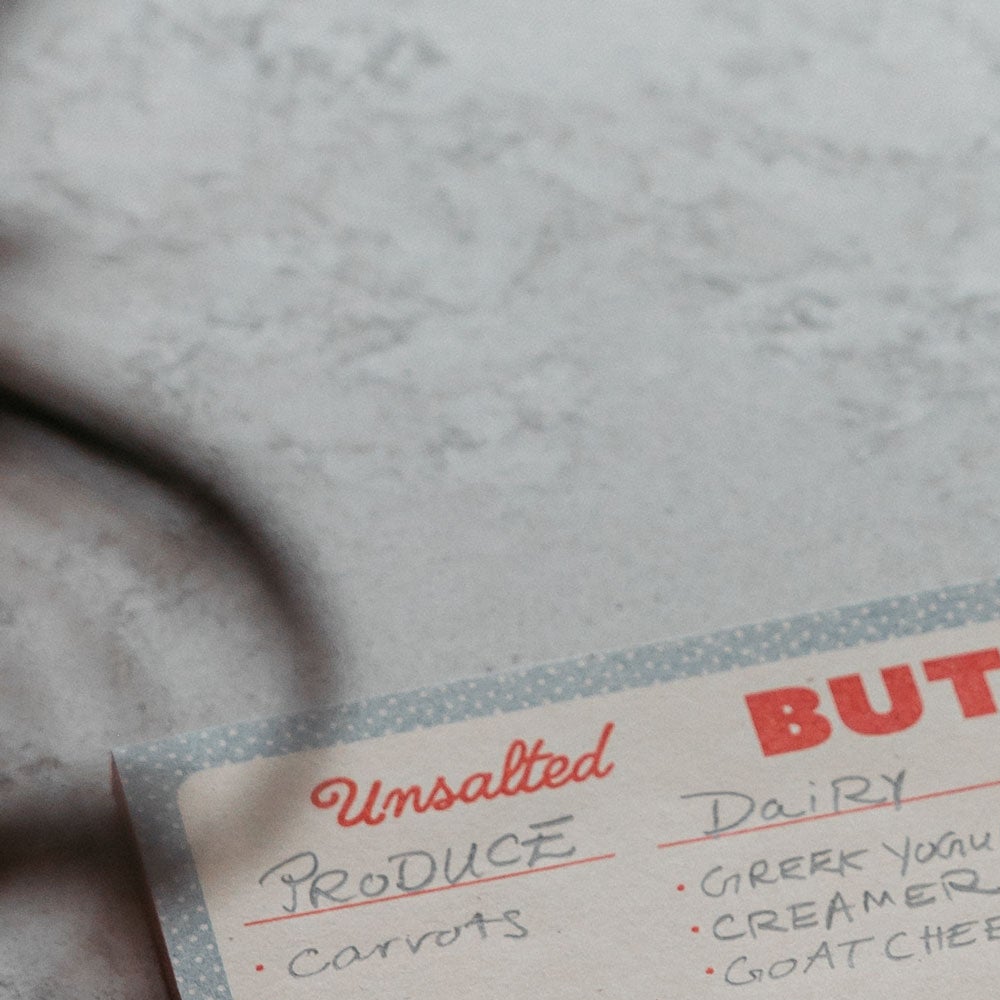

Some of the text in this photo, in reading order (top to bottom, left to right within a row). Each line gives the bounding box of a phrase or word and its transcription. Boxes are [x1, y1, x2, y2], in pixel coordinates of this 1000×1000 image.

[310, 721, 616, 829] Unsalted
[700, 848, 869, 899] GREEK
[287, 908, 530, 978] carrots
[724, 936, 876, 987] GOAT
